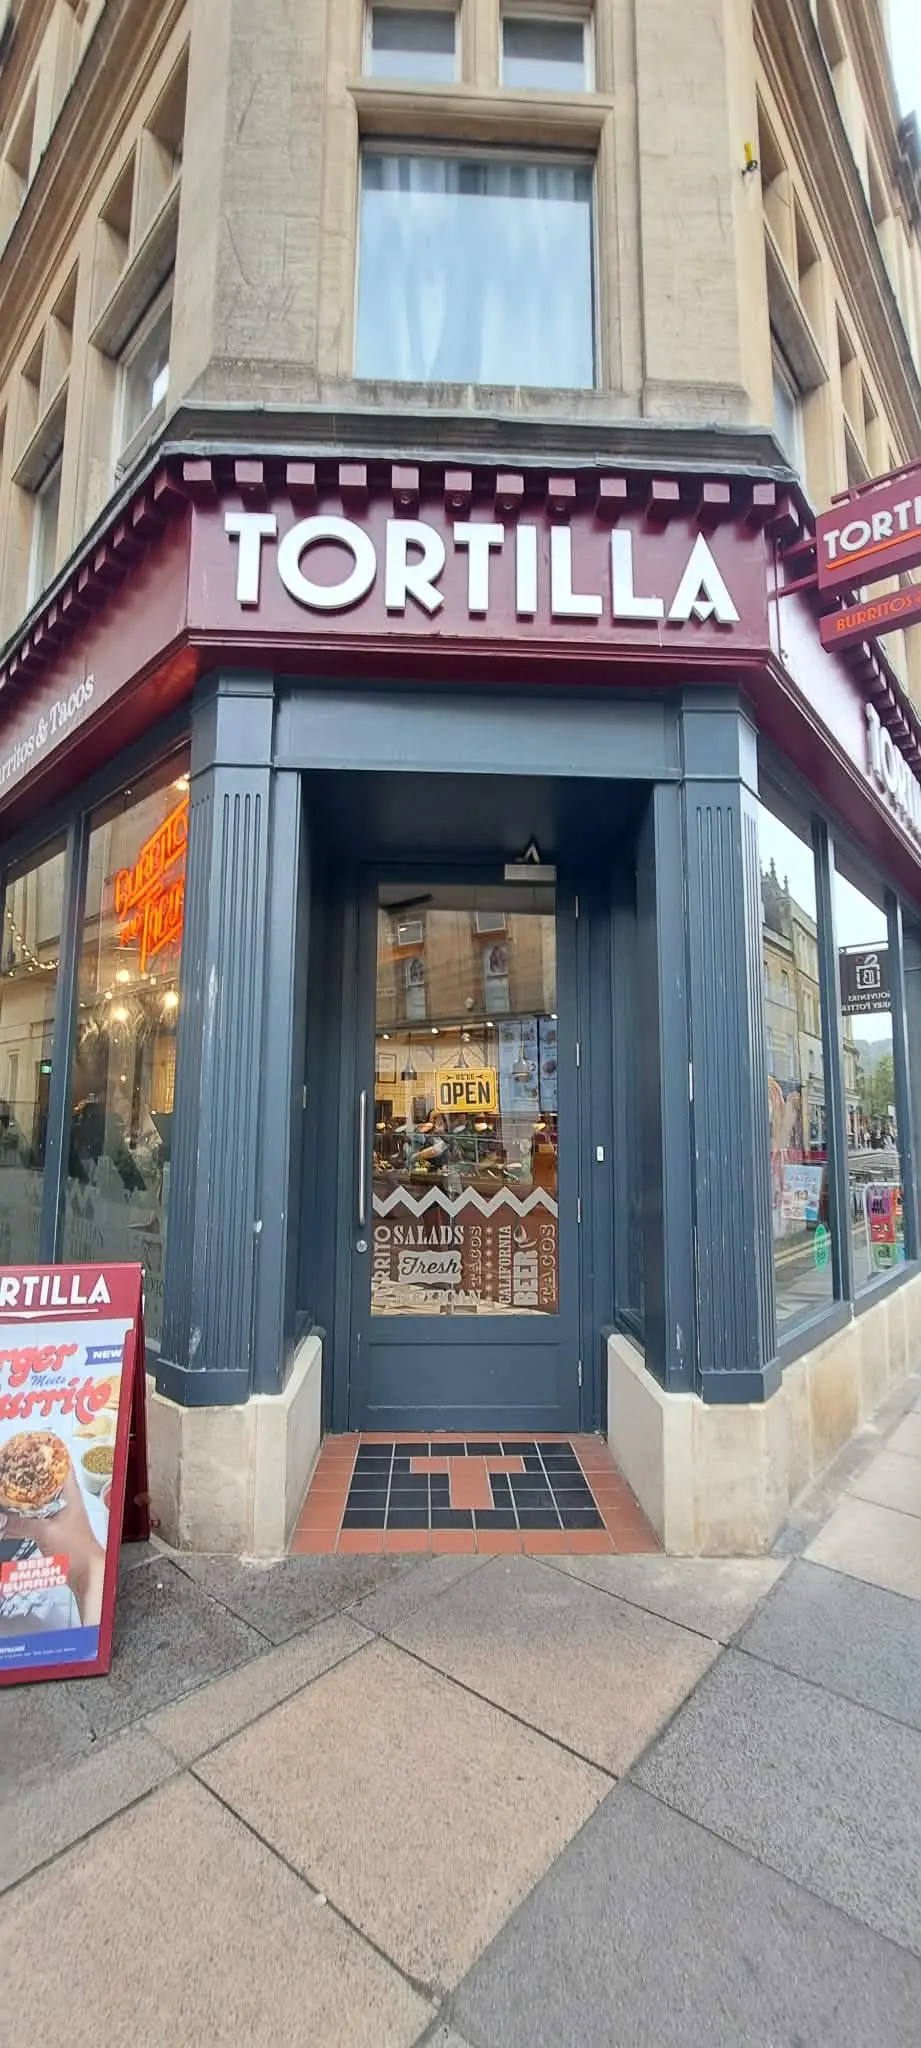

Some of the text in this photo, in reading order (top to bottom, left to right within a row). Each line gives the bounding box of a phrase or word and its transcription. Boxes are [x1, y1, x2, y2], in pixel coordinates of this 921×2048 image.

[224, 511, 741, 625] TORTILLA
[836, 595, 912, 632] BURRITOS
[35, 717, 48, 749] &
[440, 1081, 491, 1105] OPEN
[393, 1225, 465, 1245] SALADS
[400, 1256, 461, 1276] Fresh
[466, 1225, 482, 1289] TACOS
[498, 1224, 512, 1304] CALIFORNIA
[539, 1223, 556, 1305] TACOS
[0, 1274, 111, 1307] RTILLA
[513, 1250, 539, 1306] BEER
[10, 1566, 61, 1581] SMASH
[17, 1557, 54, 1570] BEEF
